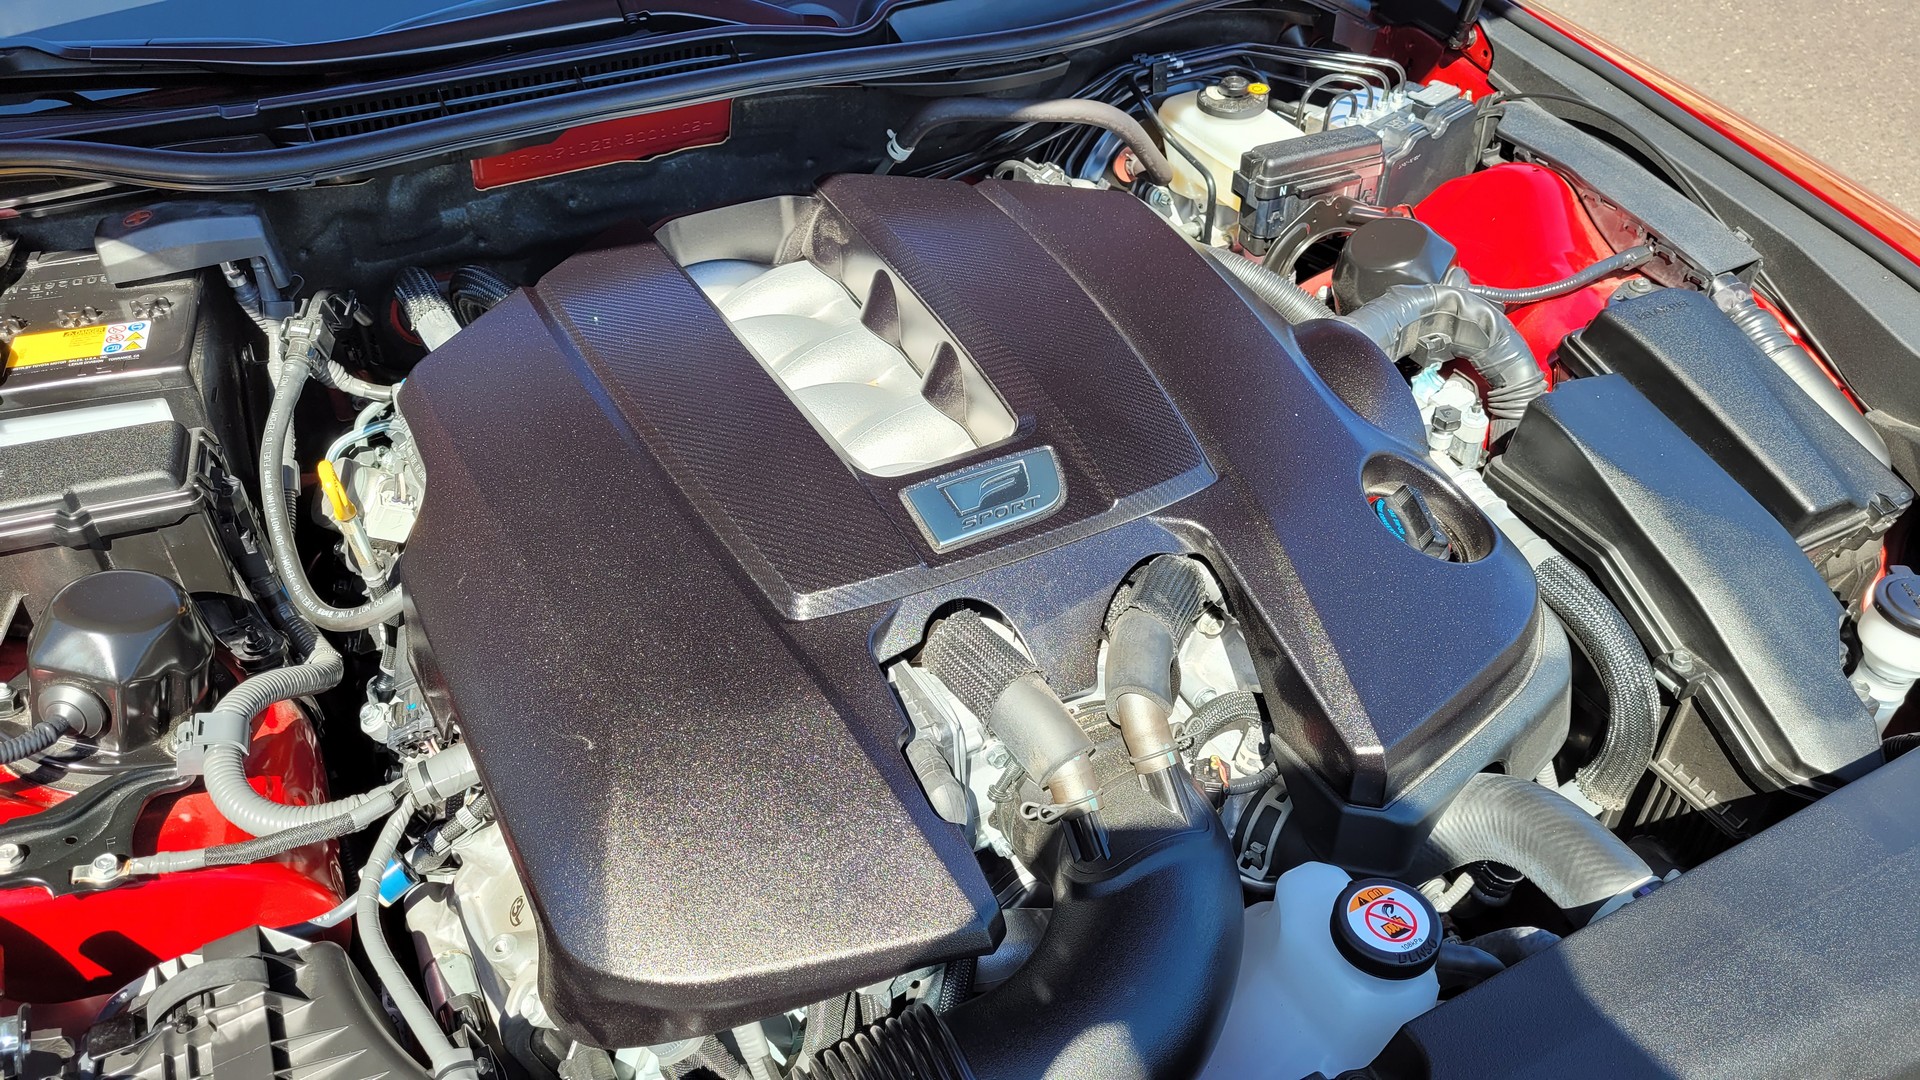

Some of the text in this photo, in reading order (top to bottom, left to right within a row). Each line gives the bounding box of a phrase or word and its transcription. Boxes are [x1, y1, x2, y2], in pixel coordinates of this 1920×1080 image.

[961, 494, 1041, 531] SPORT
[270, 517, 281, 532] NOT
[275, 535, 285, 546] DO
[1398, 938, 1438, 964] DENSO
[1401, 937, 1424, 951] 108kPa
